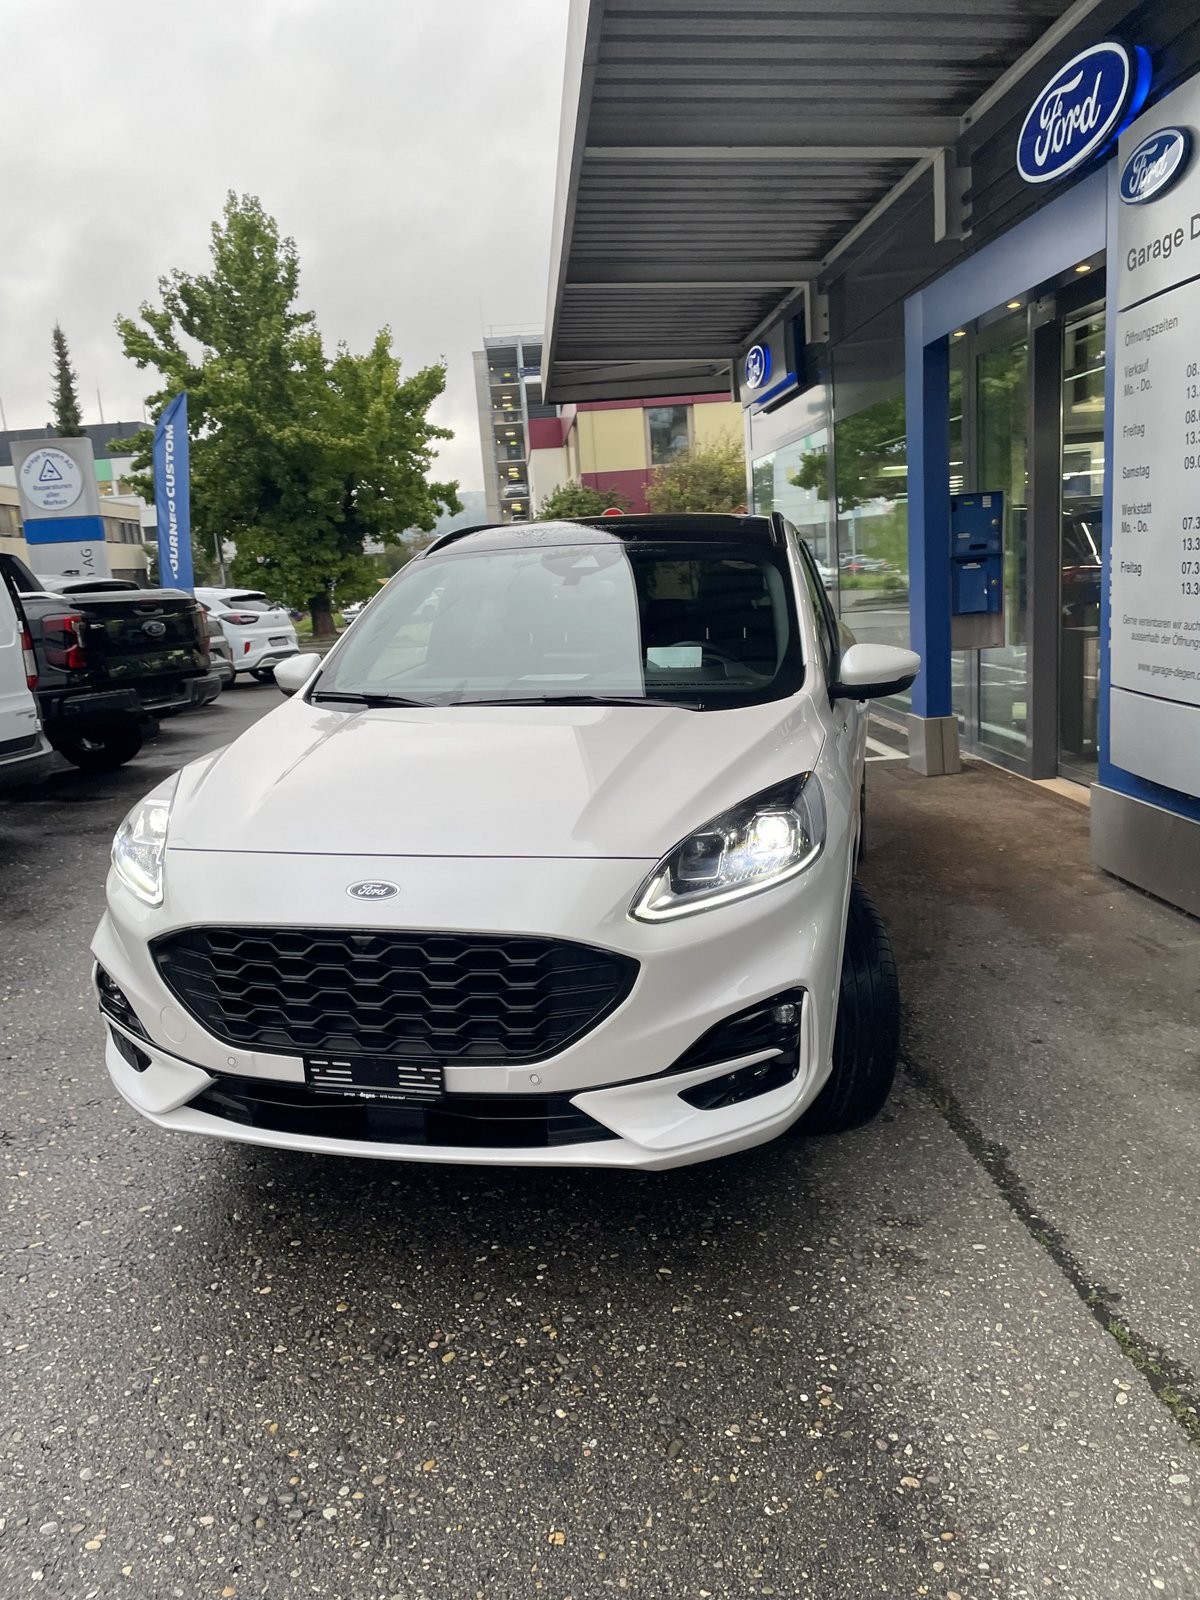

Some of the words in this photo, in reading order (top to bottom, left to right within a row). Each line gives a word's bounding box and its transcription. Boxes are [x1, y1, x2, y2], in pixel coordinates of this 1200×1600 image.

[1034, 70, 1103, 167] Ford
[1129, 143, 1169, 195] Ford
[1126, 227, 1185, 272] Garage
[1125, 316, 1178, 347] Öffnungszeiten
[1124, 358, 1149, 378] Verkauf
[1140, 379, 1153, 392] Do.
[1186, 384, 1200, 399] 13.
[1185, 409, 1200, 424] 08.
[1123, 423, 1146, 439] Freitag
[165, 424, 176, 497] CUSTOM
[1122, 464, 1151, 480] Samstag
[1121, 501, 1152, 516] Werkstatt
[1137, 520, 1149, 532] Do.
[80, 548, 95, 568] AG
[1120, 561, 1142, 577] Freitag
[1181, 582, 1200, 595] 13.3
[357, 883, 389, 896] Ford
